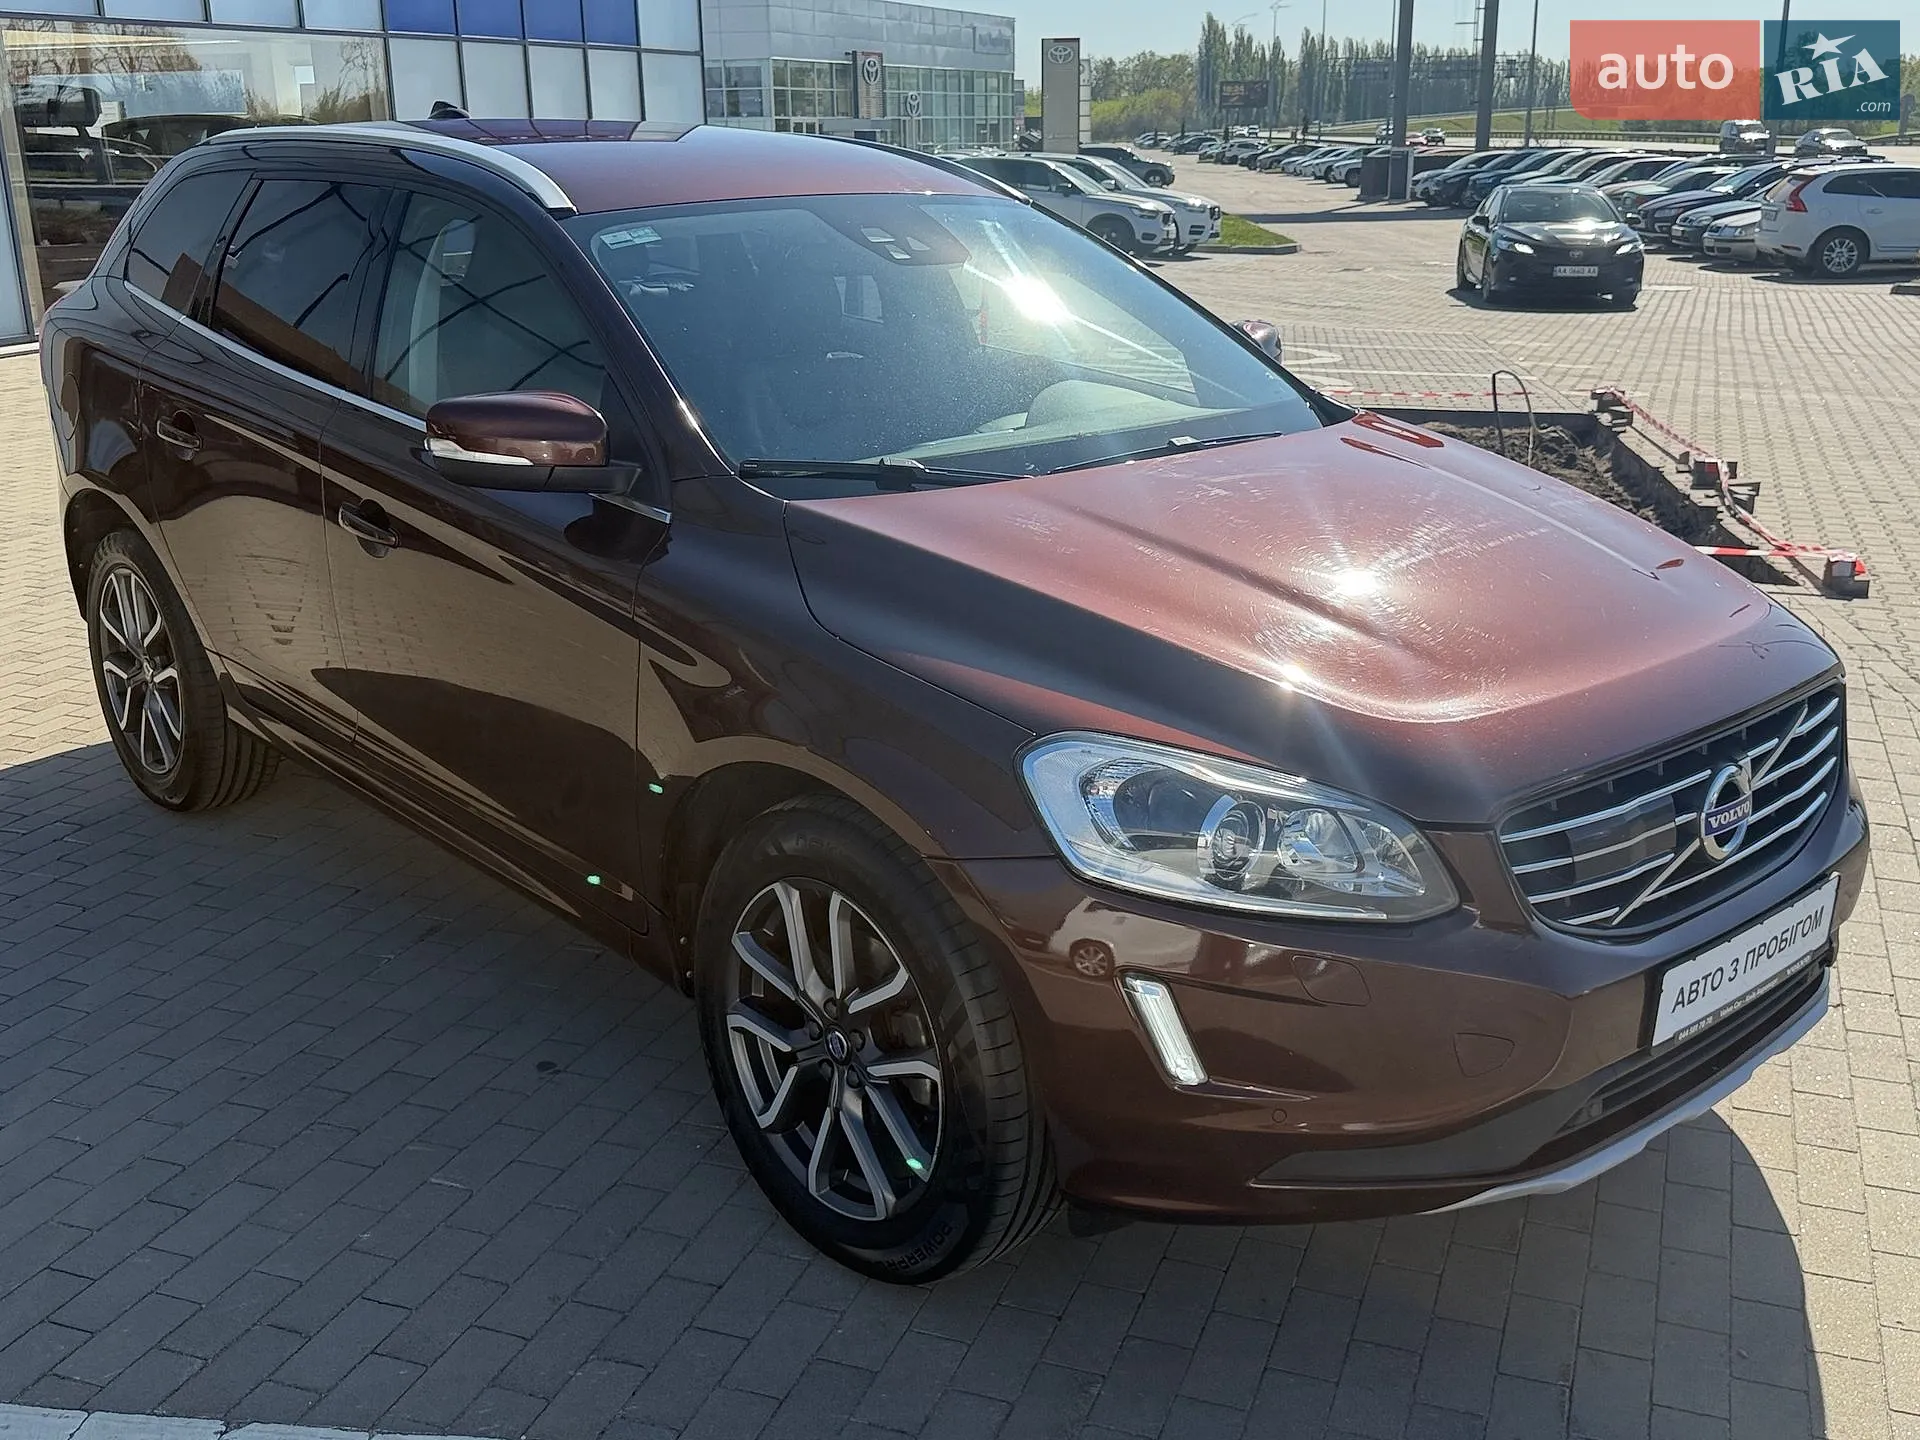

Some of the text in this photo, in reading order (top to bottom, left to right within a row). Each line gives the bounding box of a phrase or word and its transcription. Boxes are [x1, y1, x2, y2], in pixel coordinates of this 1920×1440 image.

[1708, 801, 1750, 829] VOLVO
[1671, 966, 1724, 1014] АВТО
[1728, 957, 1739, 982] З
[1742, 905, 1825, 975] ПРОБІГОМ
